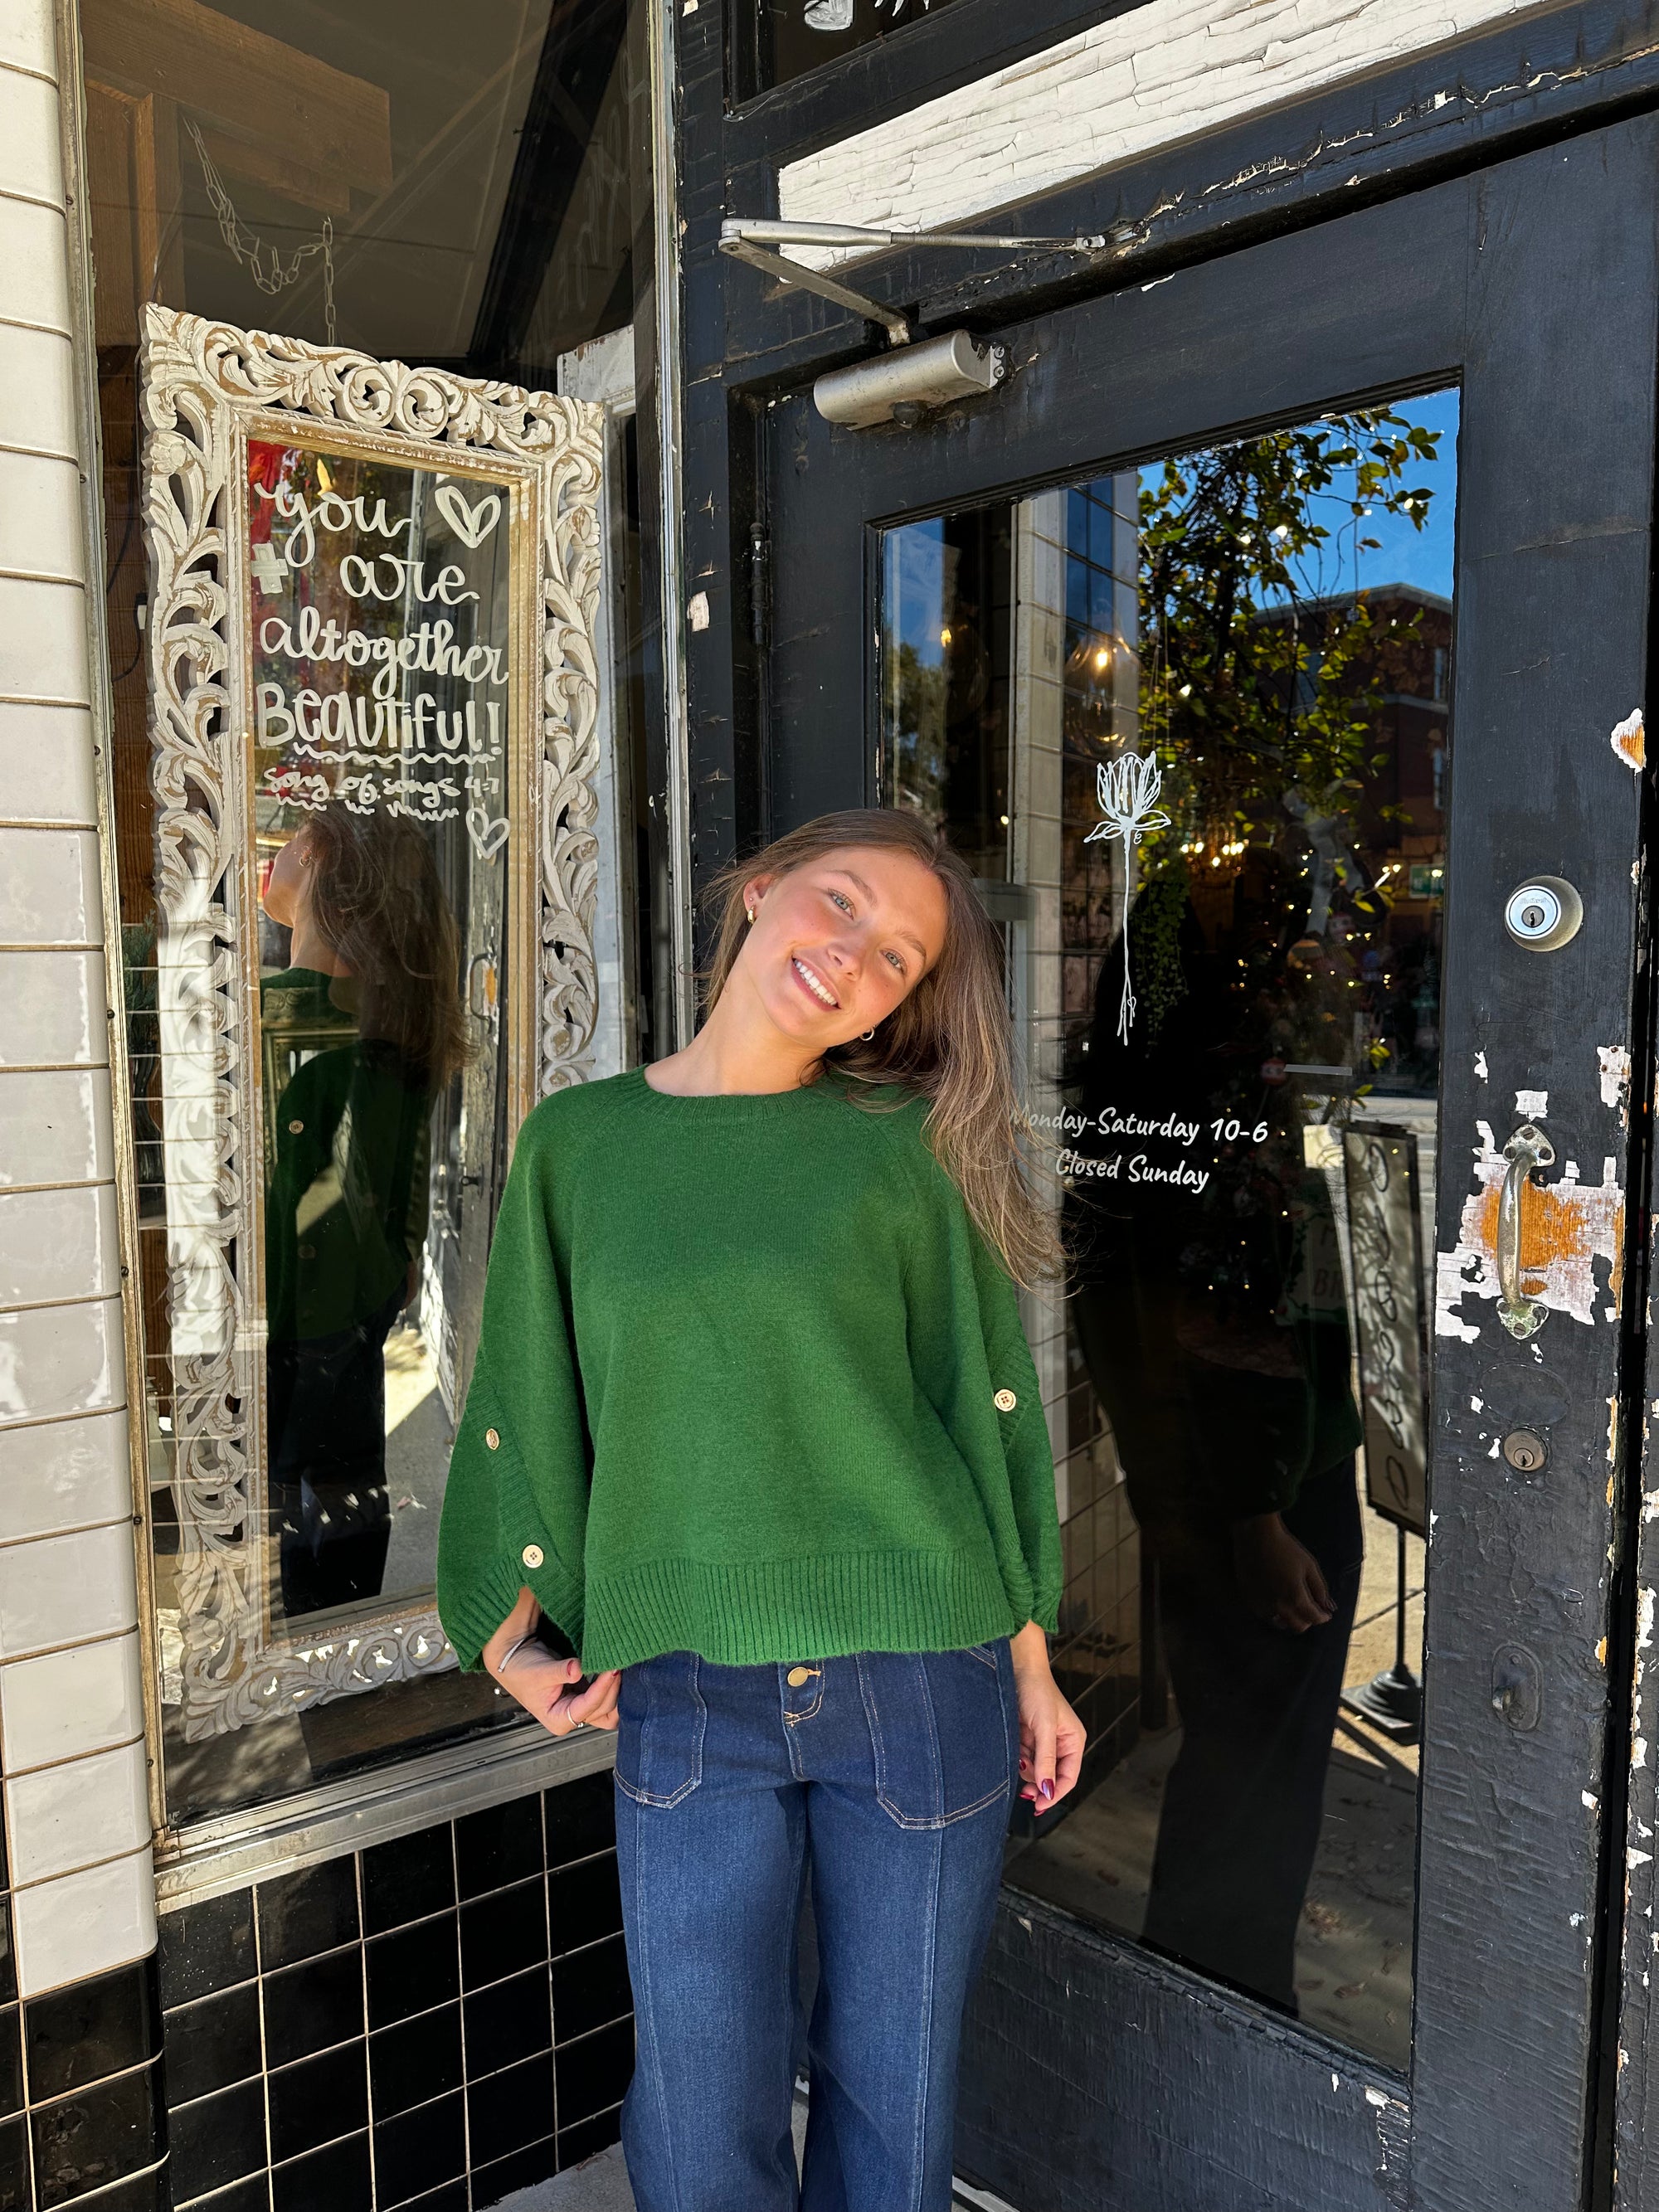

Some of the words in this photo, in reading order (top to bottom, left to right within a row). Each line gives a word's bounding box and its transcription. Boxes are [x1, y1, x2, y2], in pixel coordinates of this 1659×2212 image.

[254, 483, 412, 567] you
[340, 553, 480, 605] are
[260, 605, 508, 700] altogether
[341, 772, 377, 805] of
[1209, 1118, 1268, 1142] 10-6
[1055, 1148, 1122, 1179] Closed
[1127, 1154, 1209, 1194] Sunday
